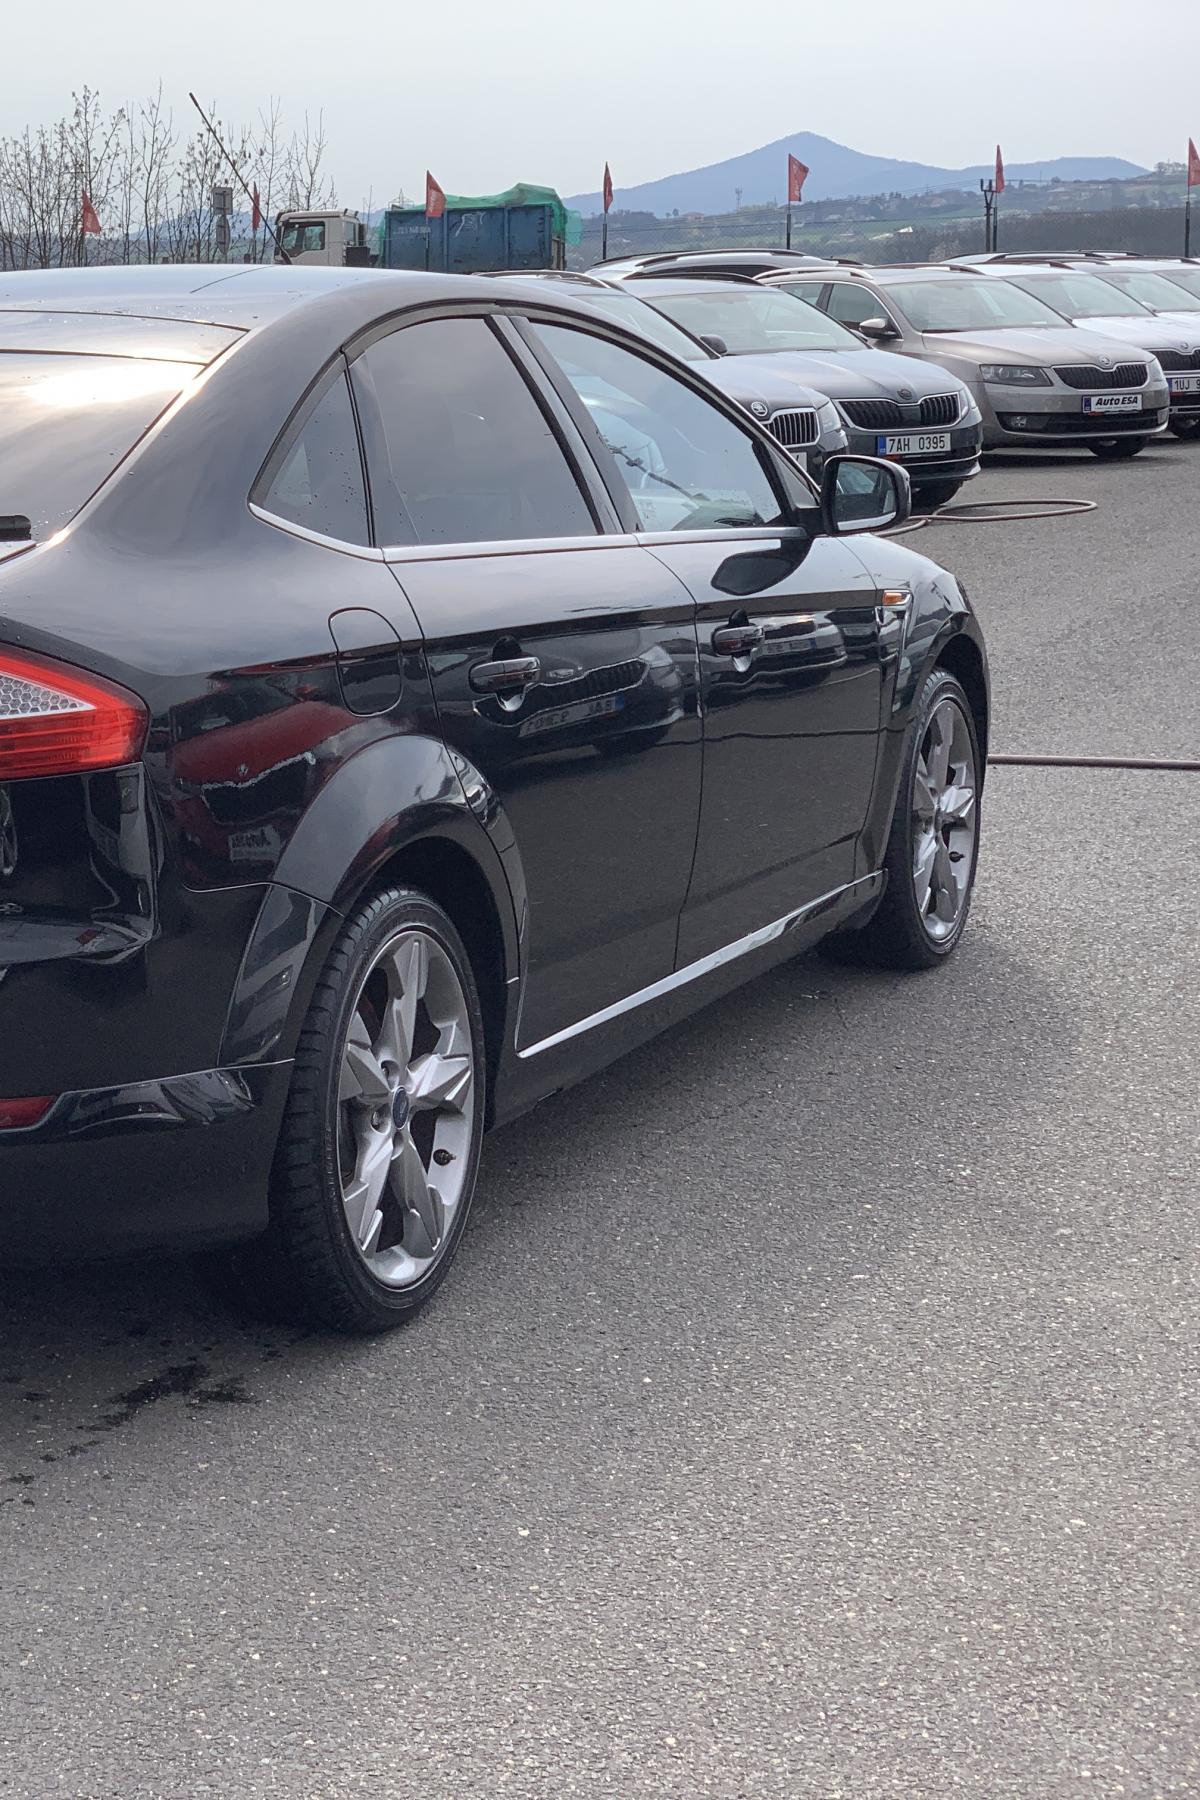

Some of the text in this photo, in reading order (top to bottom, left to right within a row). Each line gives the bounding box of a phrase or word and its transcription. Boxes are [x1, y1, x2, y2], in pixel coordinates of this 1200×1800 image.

[1174, 379, 1190, 390] 1UJ
[1095, 396, 1138, 406] Auto ESA
[888, 435, 945, 452] 7AH 0395
